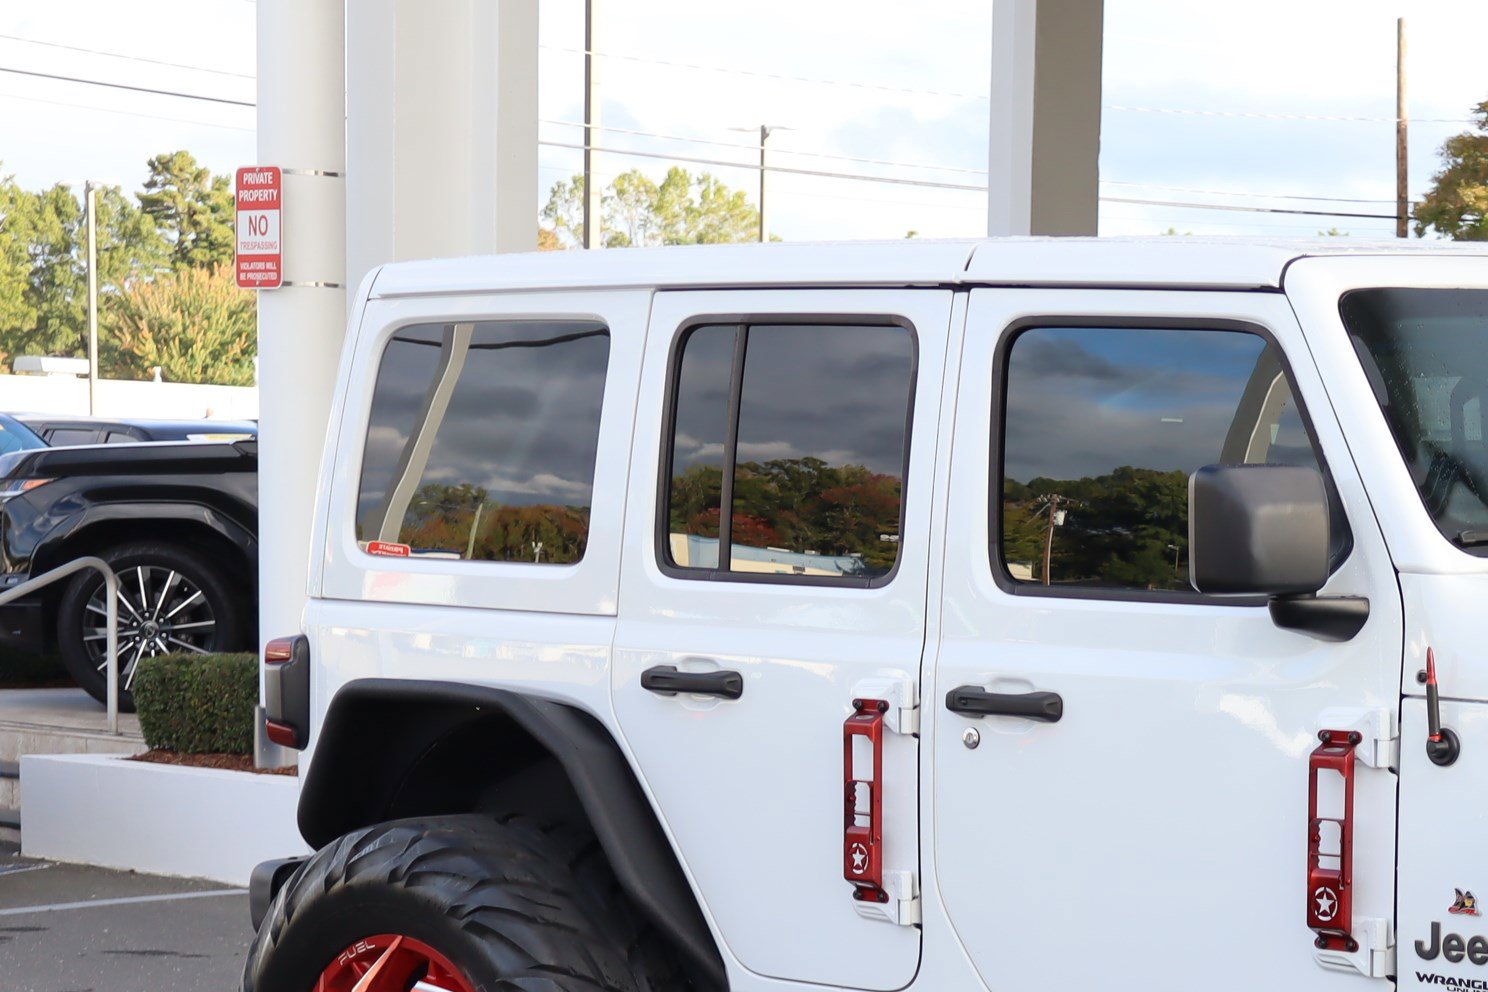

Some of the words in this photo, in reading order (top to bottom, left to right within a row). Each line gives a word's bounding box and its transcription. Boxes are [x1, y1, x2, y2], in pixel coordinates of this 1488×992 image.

[243, 171, 273, 185] PRIVATE
[238, 188, 278, 202] PROPERTY
[248, 214, 269, 237] NO
[240, 241, 278, 251] TRESPASSING
[338, 940, 376, 966] FUEL
